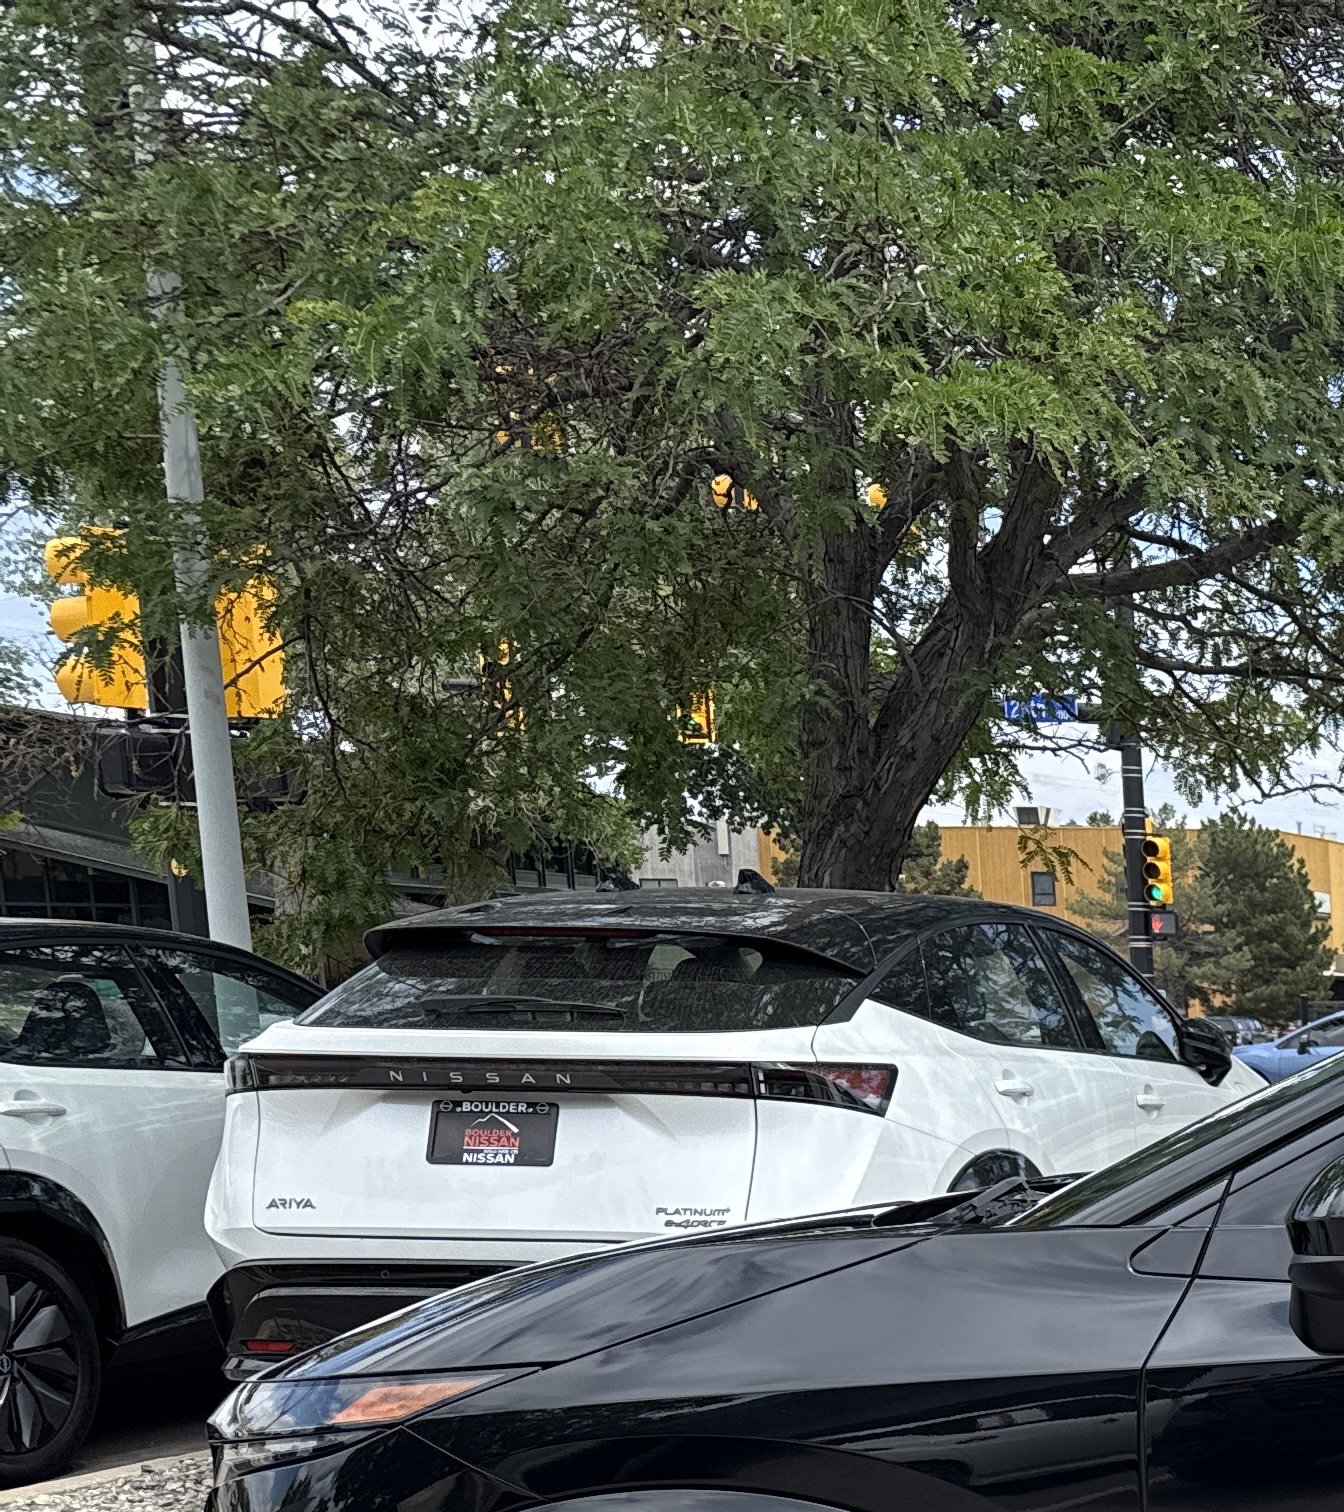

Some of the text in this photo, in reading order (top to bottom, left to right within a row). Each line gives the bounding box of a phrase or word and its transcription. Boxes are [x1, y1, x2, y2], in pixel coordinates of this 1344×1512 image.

[389, 1070, 571, 1084] NISSAN
[462, 1102, 527, 1113] BOULDER
[464, 1128, 512, 1137] BOULDER
[463, 1137, 520, 1147] NISSAN
[462, 1153, 515, 1163] NISSAN
[266, 1198, 316, 1209] ARIYA
